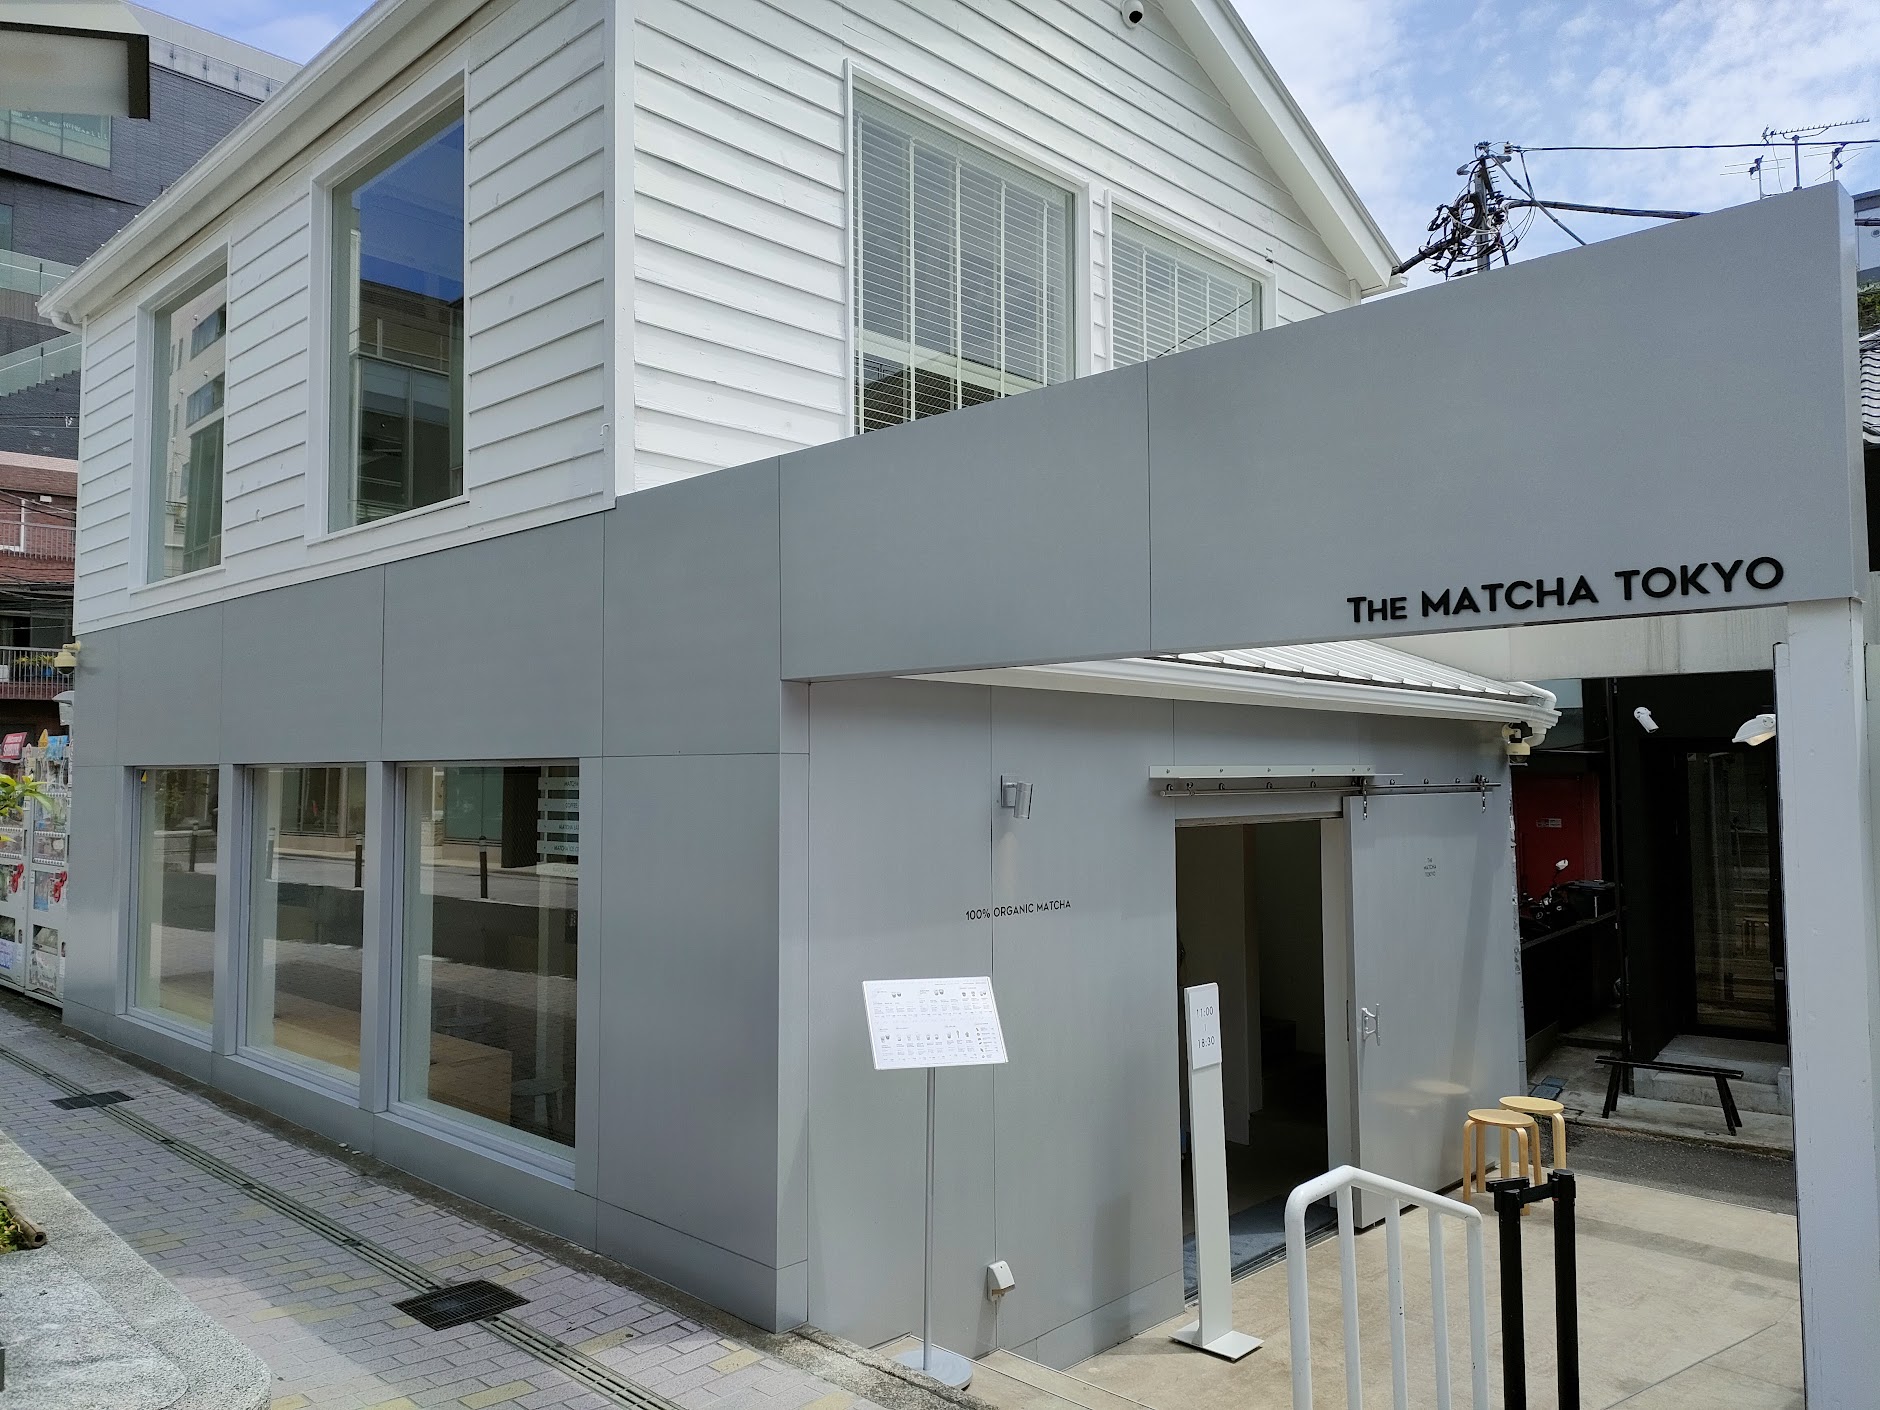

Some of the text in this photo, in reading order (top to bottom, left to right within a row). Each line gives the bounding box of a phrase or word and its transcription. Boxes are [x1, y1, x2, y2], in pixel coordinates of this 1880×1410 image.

[1346, 556, 1784, 623] THE MATCHA TOKYO
[965, 900, 1071, 920] 100% ORGANIC MATCHA
[1196, 1006, 1214, 1018] 11:00
[1197, 1035, 1215, 1049] 18:30
